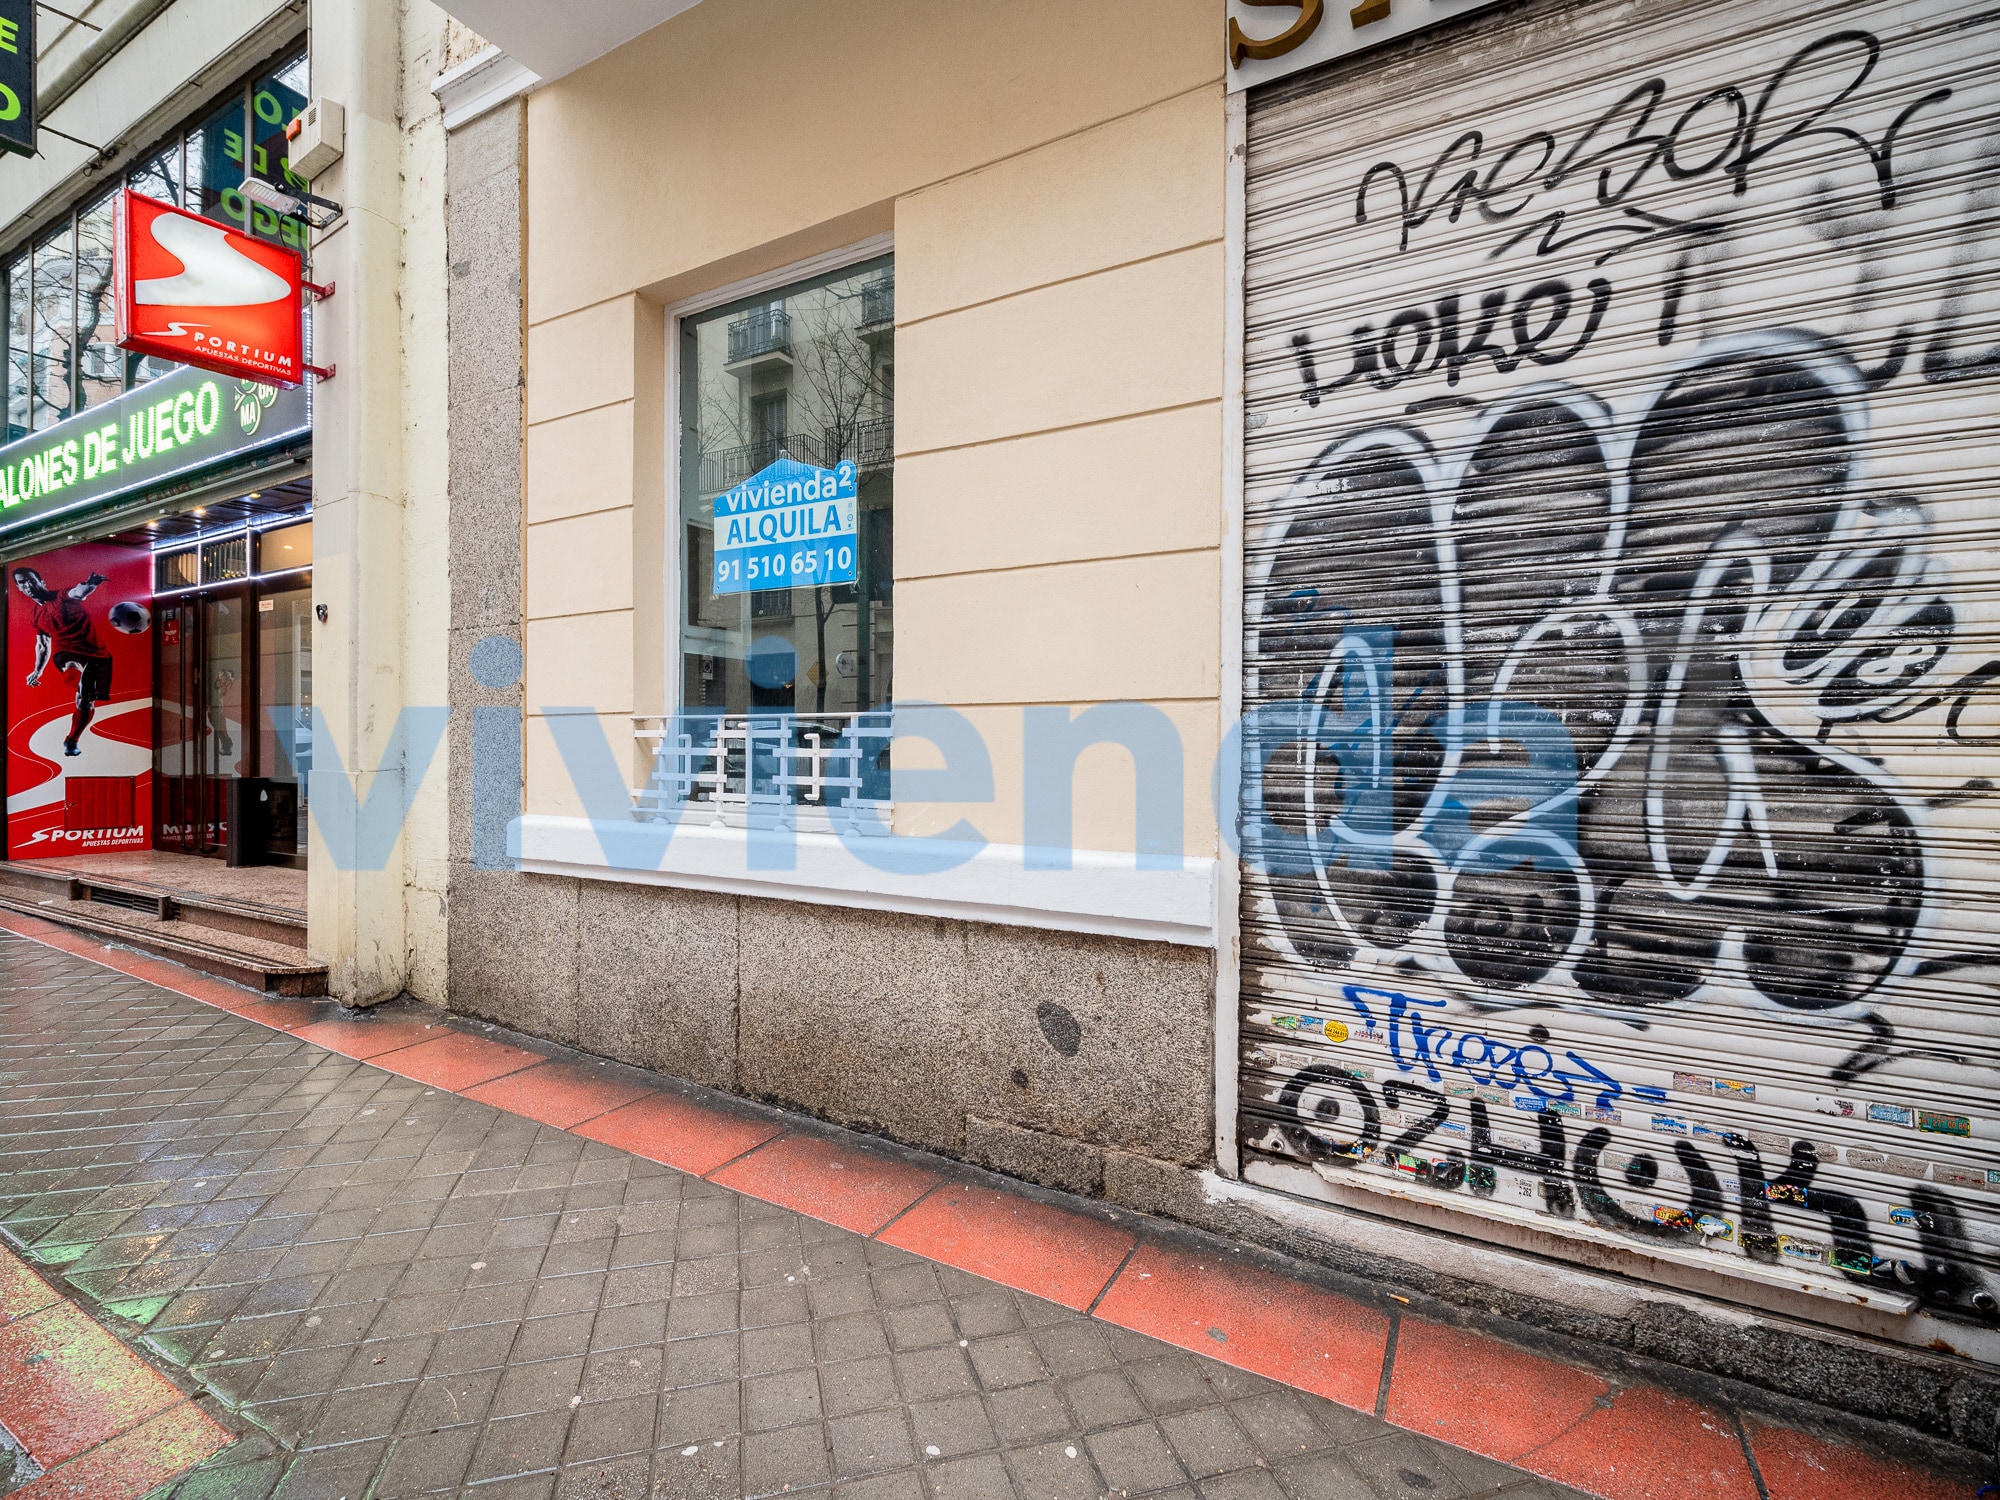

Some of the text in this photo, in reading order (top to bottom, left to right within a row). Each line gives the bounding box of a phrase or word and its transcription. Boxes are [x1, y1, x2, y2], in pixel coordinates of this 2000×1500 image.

[141, 322, 292, 367] SPORTIUM
[194, 345, 292, 376] APUESTAS DEPORTIVAS
[83, 422, 118, 480] DE
[121, 379, 220, 465] JUEGO
[726, 504, 842, 545] ALQUILA
[717, 546, 852, 583] 91 510 65 10
[12, 825, 144, 849] SPORTIUM
[82, 837, 144, 848] APUESTAS DEPORTIVAS
